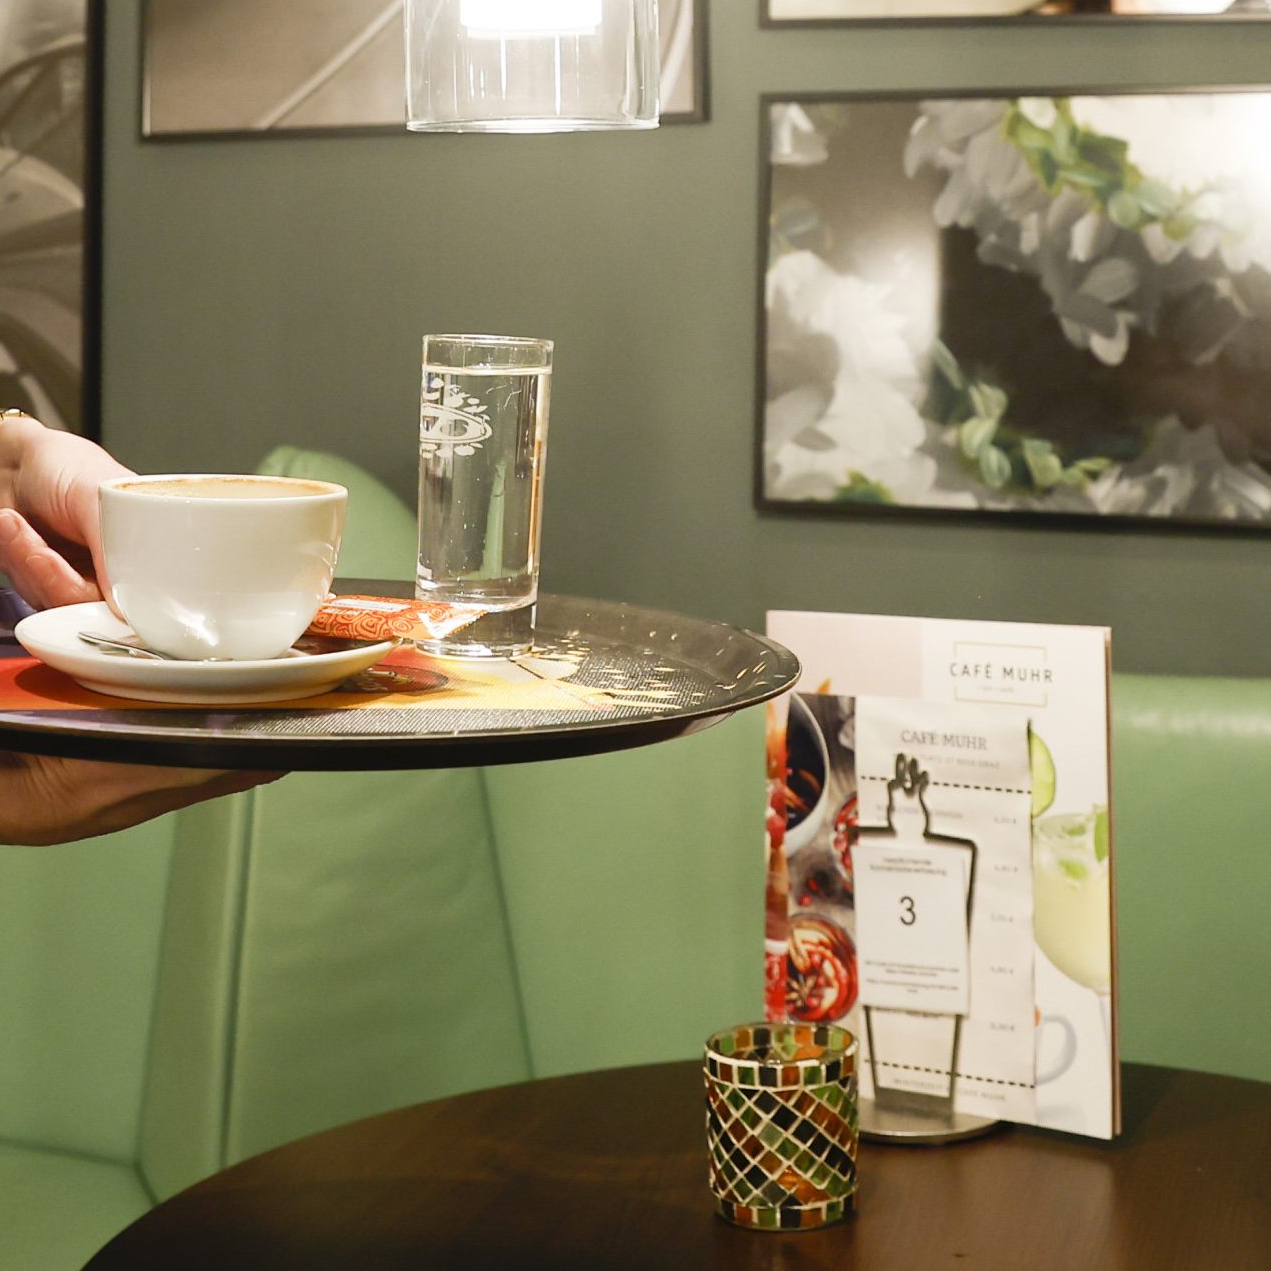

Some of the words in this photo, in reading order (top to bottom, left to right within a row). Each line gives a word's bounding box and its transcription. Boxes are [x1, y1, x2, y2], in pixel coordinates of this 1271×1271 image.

[1002, 665, 1054, 682] MUHR
[942, 733, 988, 750] MUHR
[900, 895, 916, 926] 3
